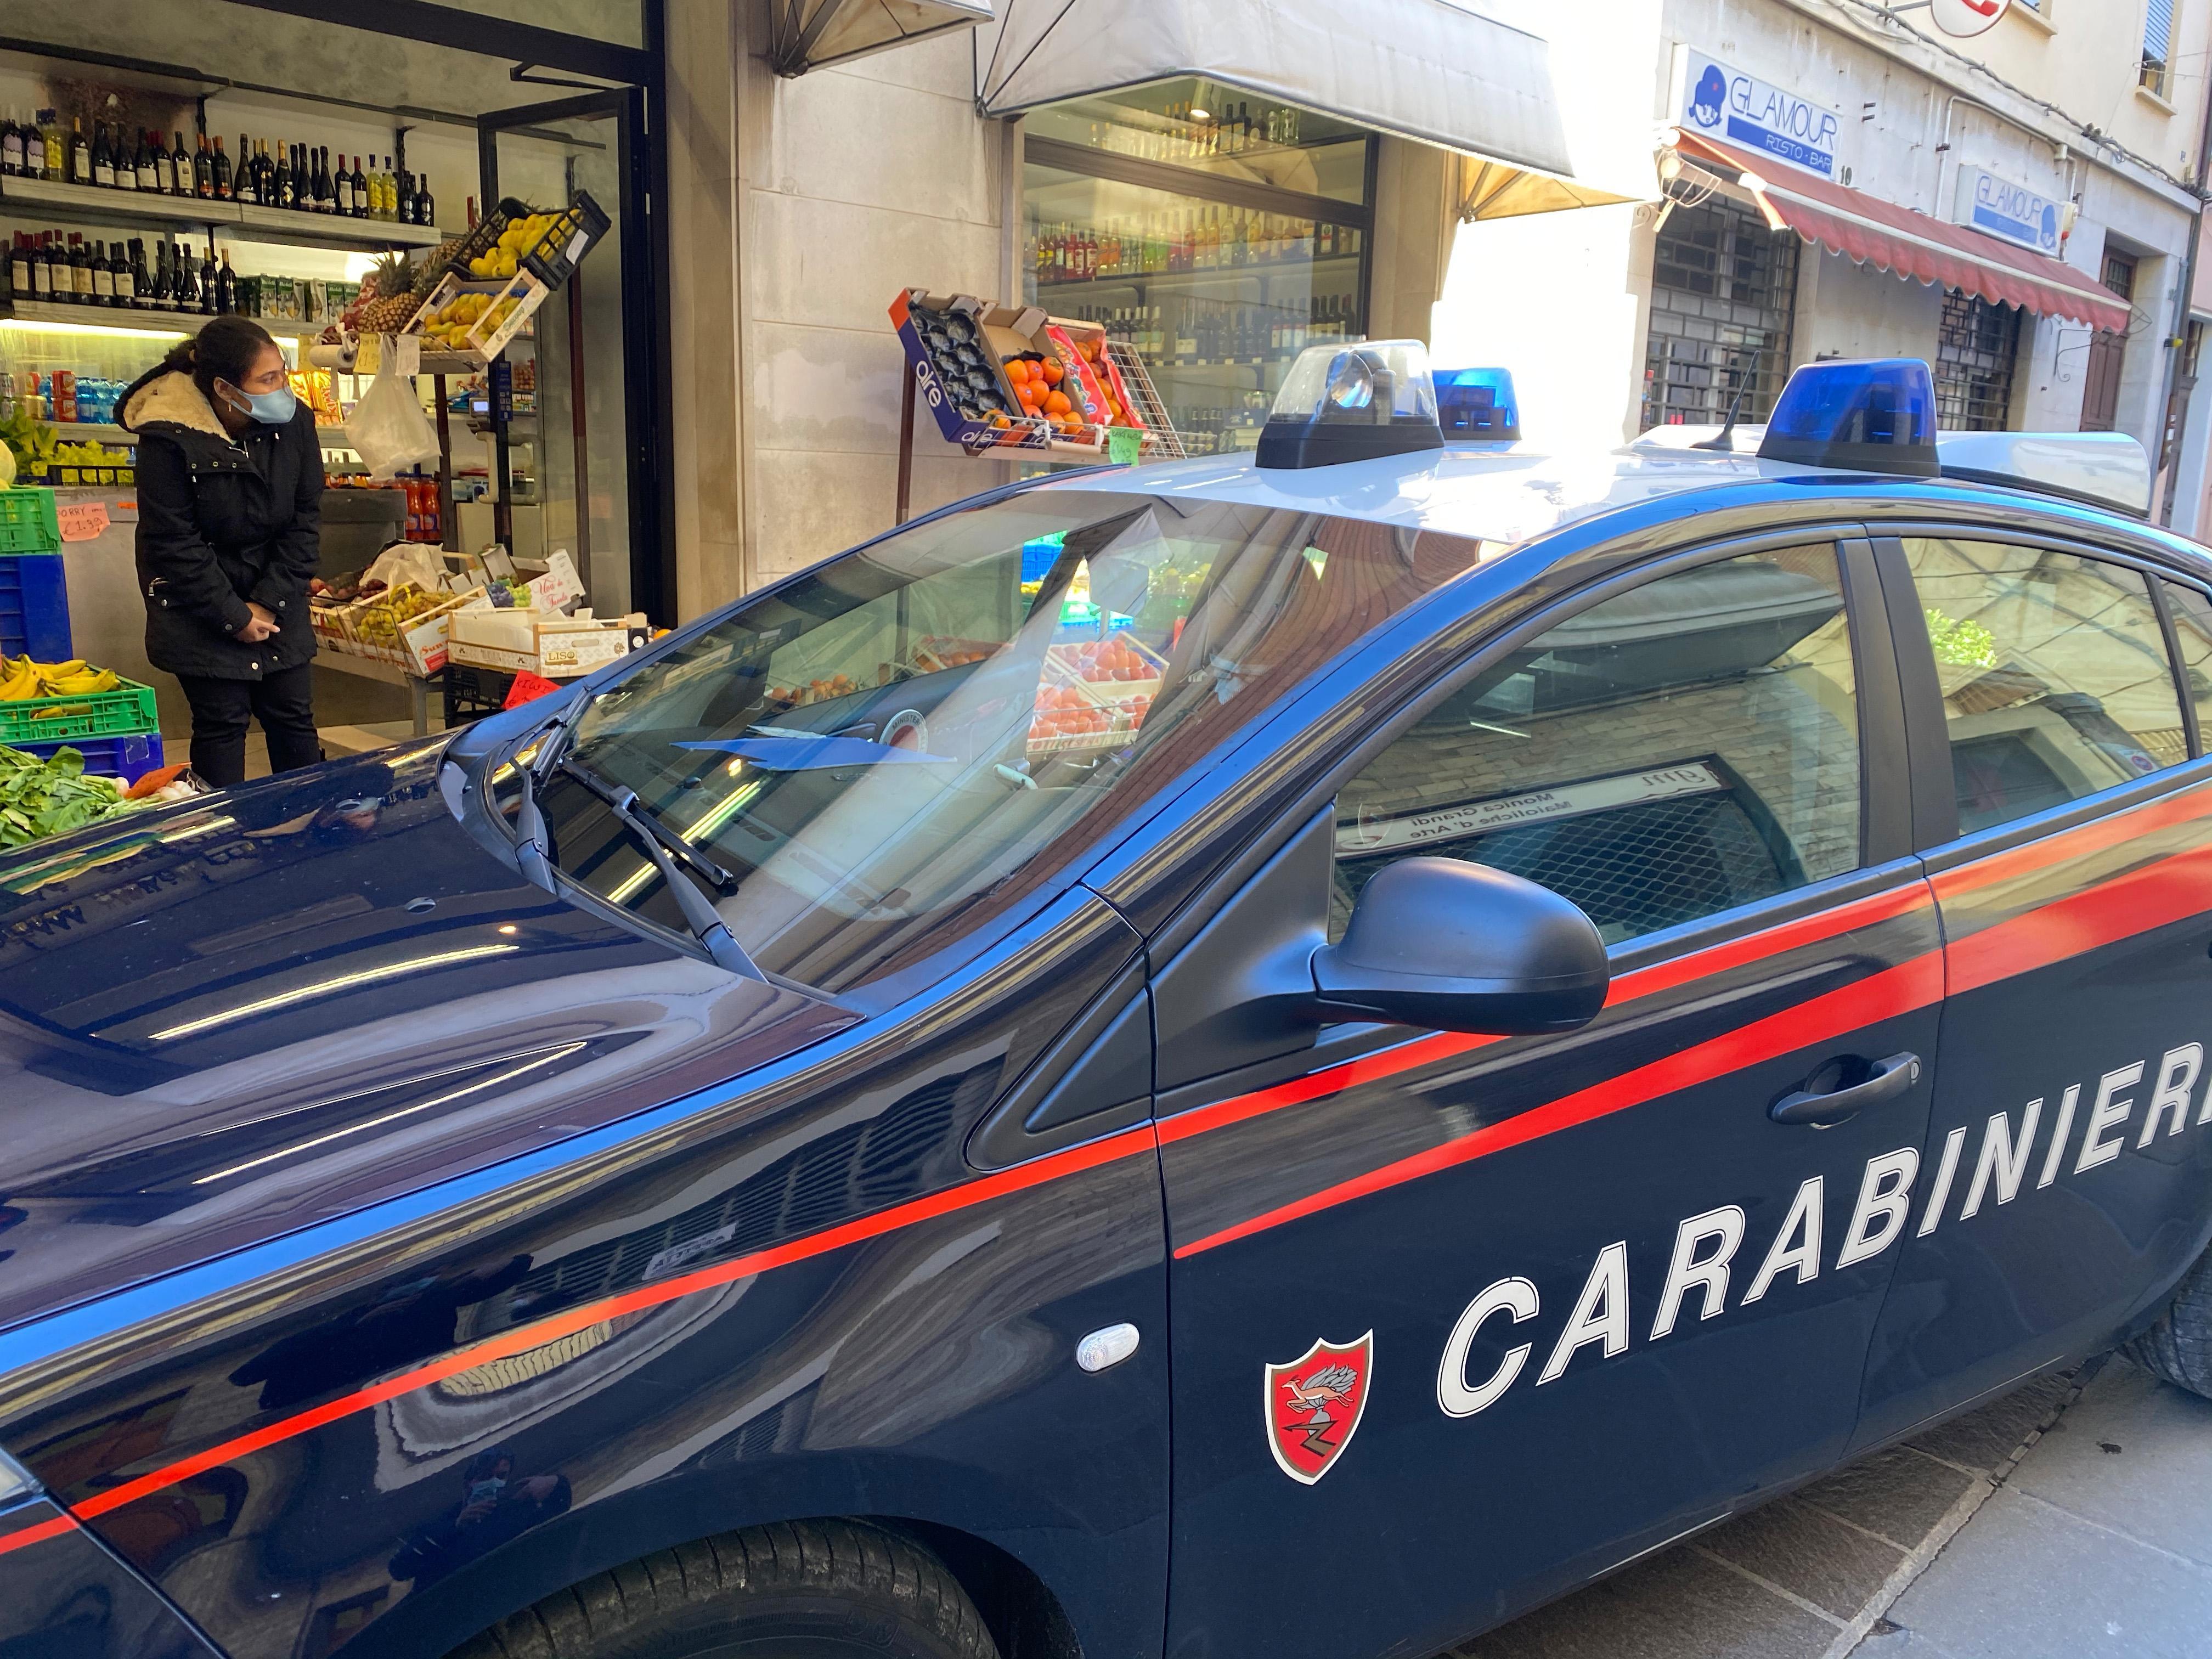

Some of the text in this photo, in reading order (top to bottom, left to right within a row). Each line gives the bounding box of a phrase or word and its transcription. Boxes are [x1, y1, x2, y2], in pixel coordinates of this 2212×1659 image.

[1731, 76, 1837, 151] GLAMOUR
[1765, 133, 1803, 159] RISTO
[1809, 151, 1832, 172] BAR
[1978, 175, 2042, 224] GLAMOUR
[549, 651, 575, 661] LISO
